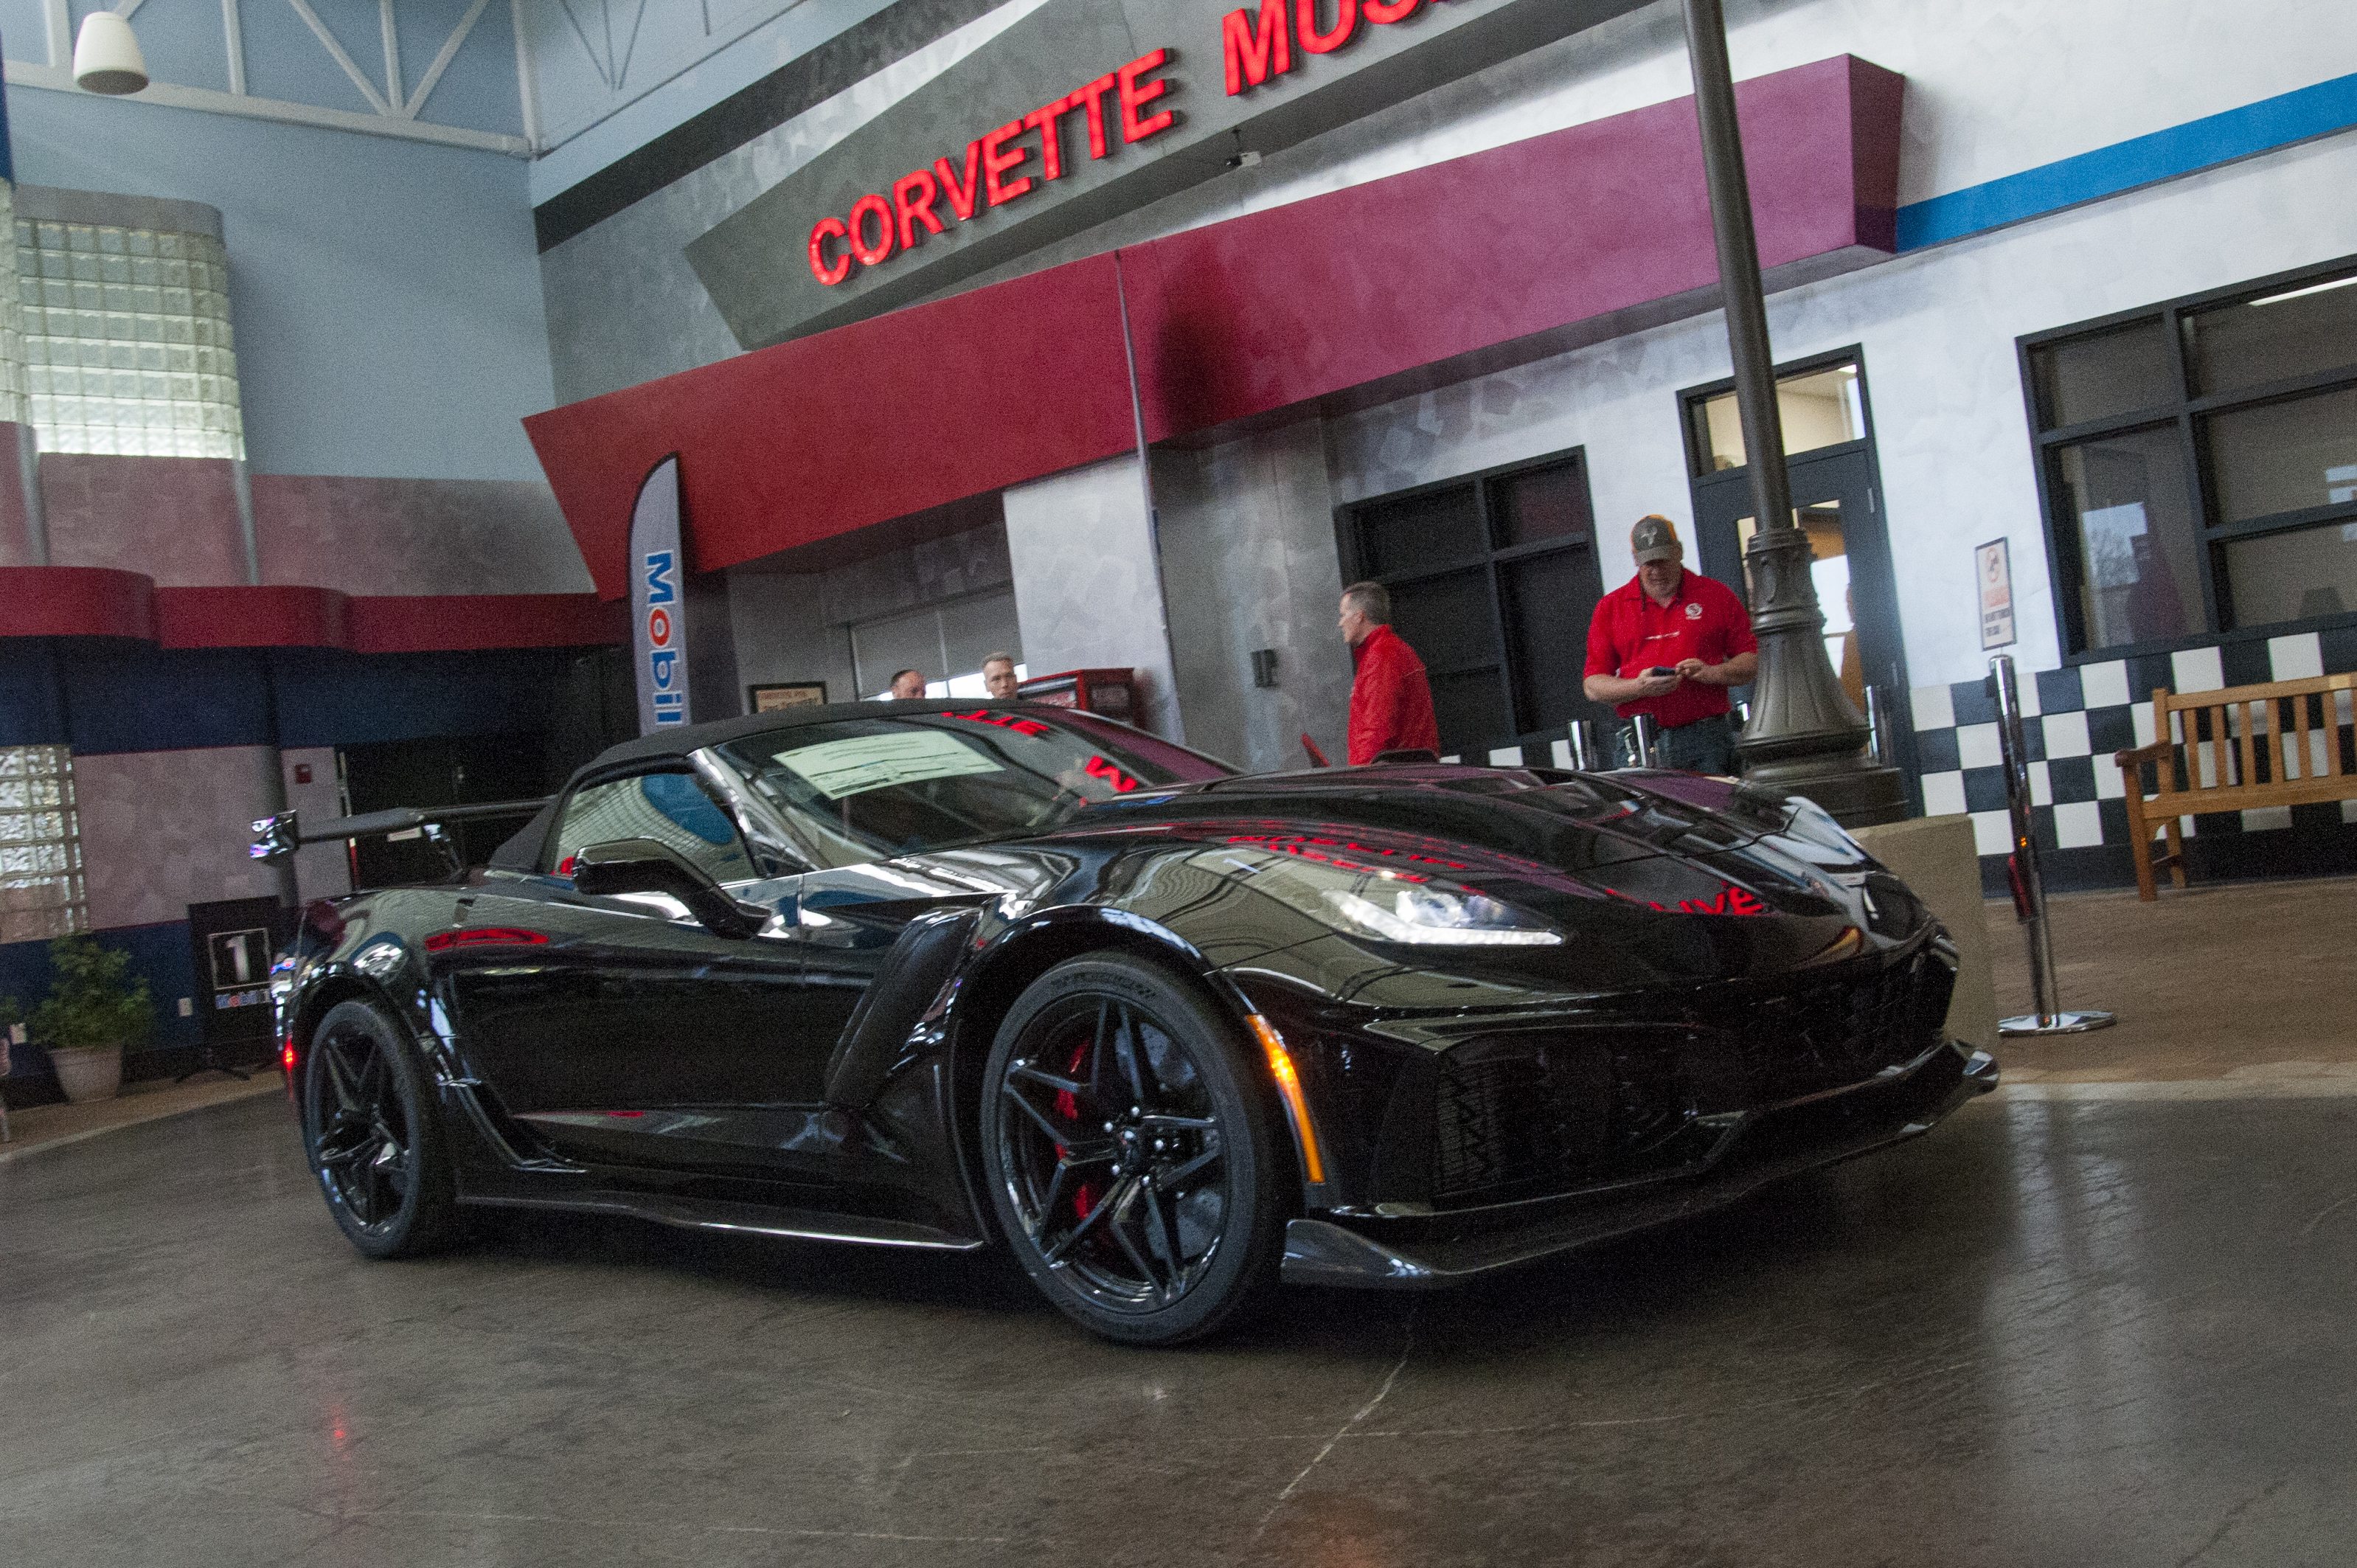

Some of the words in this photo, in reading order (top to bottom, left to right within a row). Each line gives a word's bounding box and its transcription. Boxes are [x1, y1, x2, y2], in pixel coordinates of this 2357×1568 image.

[808, 48, 1173, 285] CORVETTE
[645, 550, 683, 724] Mobil
[226, 935, 249, 982] 1
